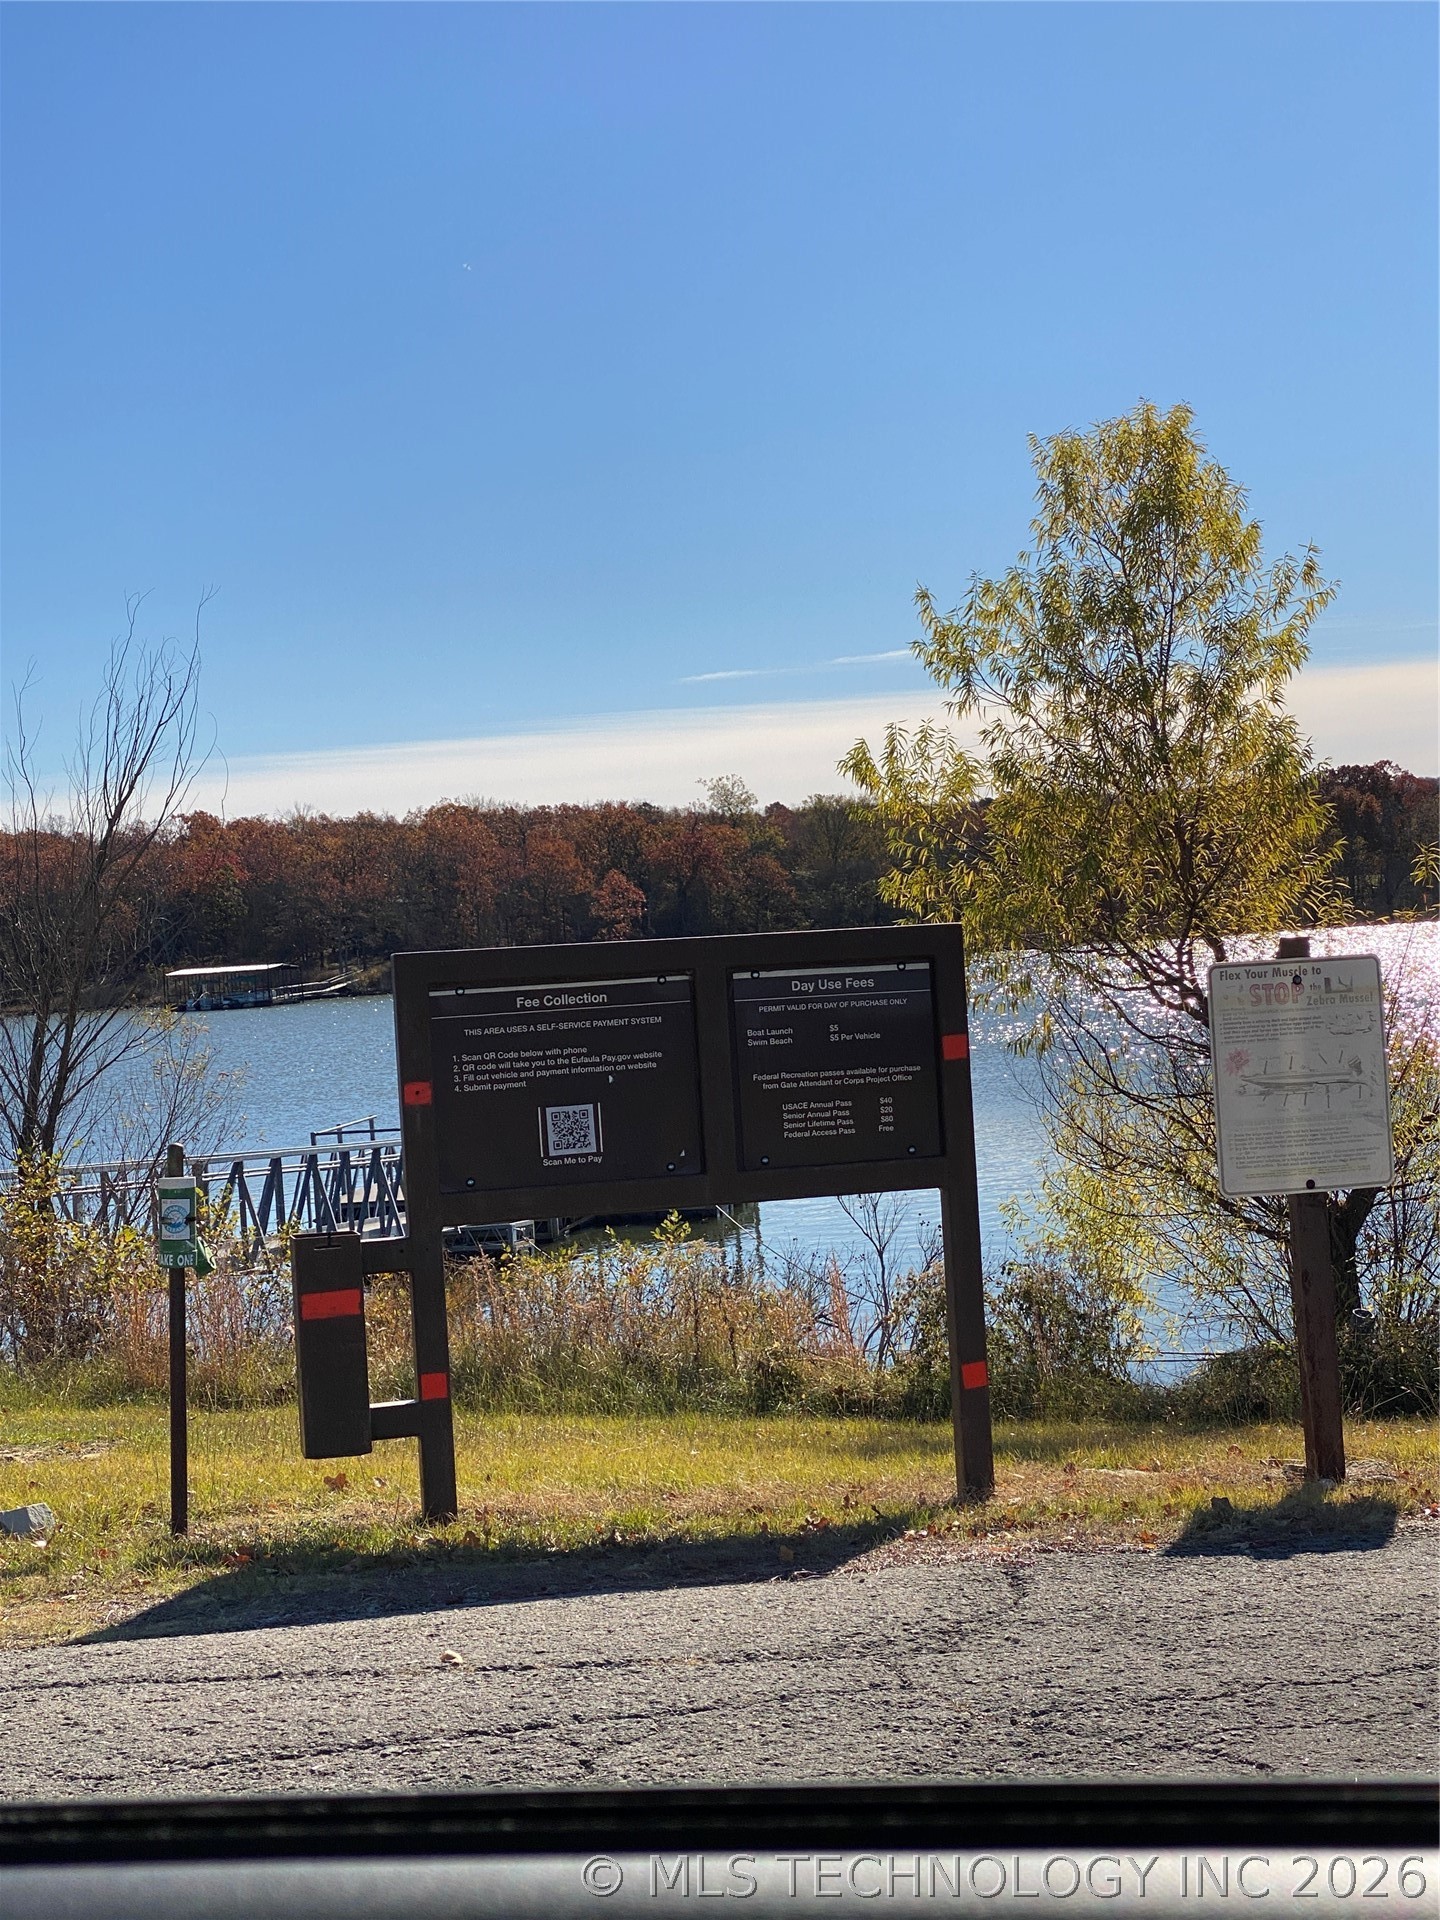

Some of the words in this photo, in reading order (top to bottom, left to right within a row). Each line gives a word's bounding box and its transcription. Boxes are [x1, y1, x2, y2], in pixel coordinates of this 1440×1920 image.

[1220, 969, 1241, 981] Flex
[1245, 968, 1268, 980] Your
[1272, 966, 1308, 978] Muscle
[1312, 966, 1322, 975] to
[791, 980, 815, 992] Day
[818, 978, 842, 990] Use
[845, 977, 874, 988] Fees
[516, 996, 540, 1008] Fee
[543, 992, 608, 1006] Collection
[1250, 982, 1306, 1008] STOP
[1310, 983, 1322, 992] the
[1306, 994, 1336, 1006] Zebra
[1339, 992, 1373, 1004] Mussel
[758, 1005, 785, 1013] PERMIT
[786, 1003, 807, 1011] VALID
[808, 1002, 823, 1010] FOR
[850, 999, 888, 1007] PURCHASE
[464, 1028, 482, 1036] THIS
[483, 1026, 505, 1035] AREA
[506, 1025, 528, 1033] USES
[529, 1024, 535, 1032] A
[536, 1020, 591, 1030] SELF-SERVICE
[593, 1018, 629, 1028] PAYMENT
[630, 1016, 662, 1025] SYSTEM
[747, 1028, 765, 1037] Boat
[766, 1027, 793, 1035] Launch
[747, 1038, 768, 1046] Swim
[769, 1037, 793, 1045] Beach
[840, 1033, 853, 1041] Per
[854, 1032, 881, 1040] Vehicle
[483, 1052, 496, 1060] QR
[498, 1051, 519, 1059] Code
[520, 1049, 543, 1057] below
[545, 1048, 561, 1056] with
[563, 1047, 587, 1055] phone
[462, 1064, 475, 1072] QR
[477, 1063, 496, 1071] code
[512, 1060, 529, 1068] take
[531, 1060, 545, 1068] you
[557, 1057, 569, 1065] the
[571, 1055, 600, 1064] Eufaula
[601, 1054, 631, 1062] Pay.gov
[632, 1051, 662, 1059] website
[491, 1071, 518, 1080] vehicle
[520, 1070, 534, 1078] and
[536, 1068, 570, 1077] payment
[571, 1065, 614, 1073] information
[627, 1061, 657, 1070] website
[752, 1072, 779, 1081] Federal
[780, 1070, 818, 1079] Recreation
[820, 1070, 845, 1079] passes
[846, 1067, 877, 1075] available
[878, 1065, 888, 1073] for
[889, 1064, 921, 1073] purchase
[463, 1083, 491, 1092] Submit
[493, 1080, 526, 1091] payment
[762, 1082, 779, 1090] from
[780, 1081, 798, 1089] Gate
[799, 1079, 833, 1087] Attendant
[843, 1077, 865, 1086] Corps
[866, 1075, 891, 1084] Project
[892, 1074, 912, 1082] Office
[782, 1102, 808, 1111] USACE
[810, 1101, 834, 1109] Annual
[782, 1112, 805, 1120] Senior
[806, 1110, 831, 1118] Annual
[832, 1109, 850, 1117] Pass
[783, 1121, 806, 1129] Senior
[807, 1119, 835, 1128] Lifetime
[836, 1118, 854, 1126] Pass
[784, 1130, 810, 1138] Federal
[812, 1128, 837, 1136] Access
[838, 1127, 856, 1135] Pass
[542, 1158, 563, 1167] Scan
[564, 1156, 576, 1164] Me
[578, 1156, 586, 1164] to
[588, 1155, 602, 1164] Pay
[177, 1254, 194, 1266] ONE
